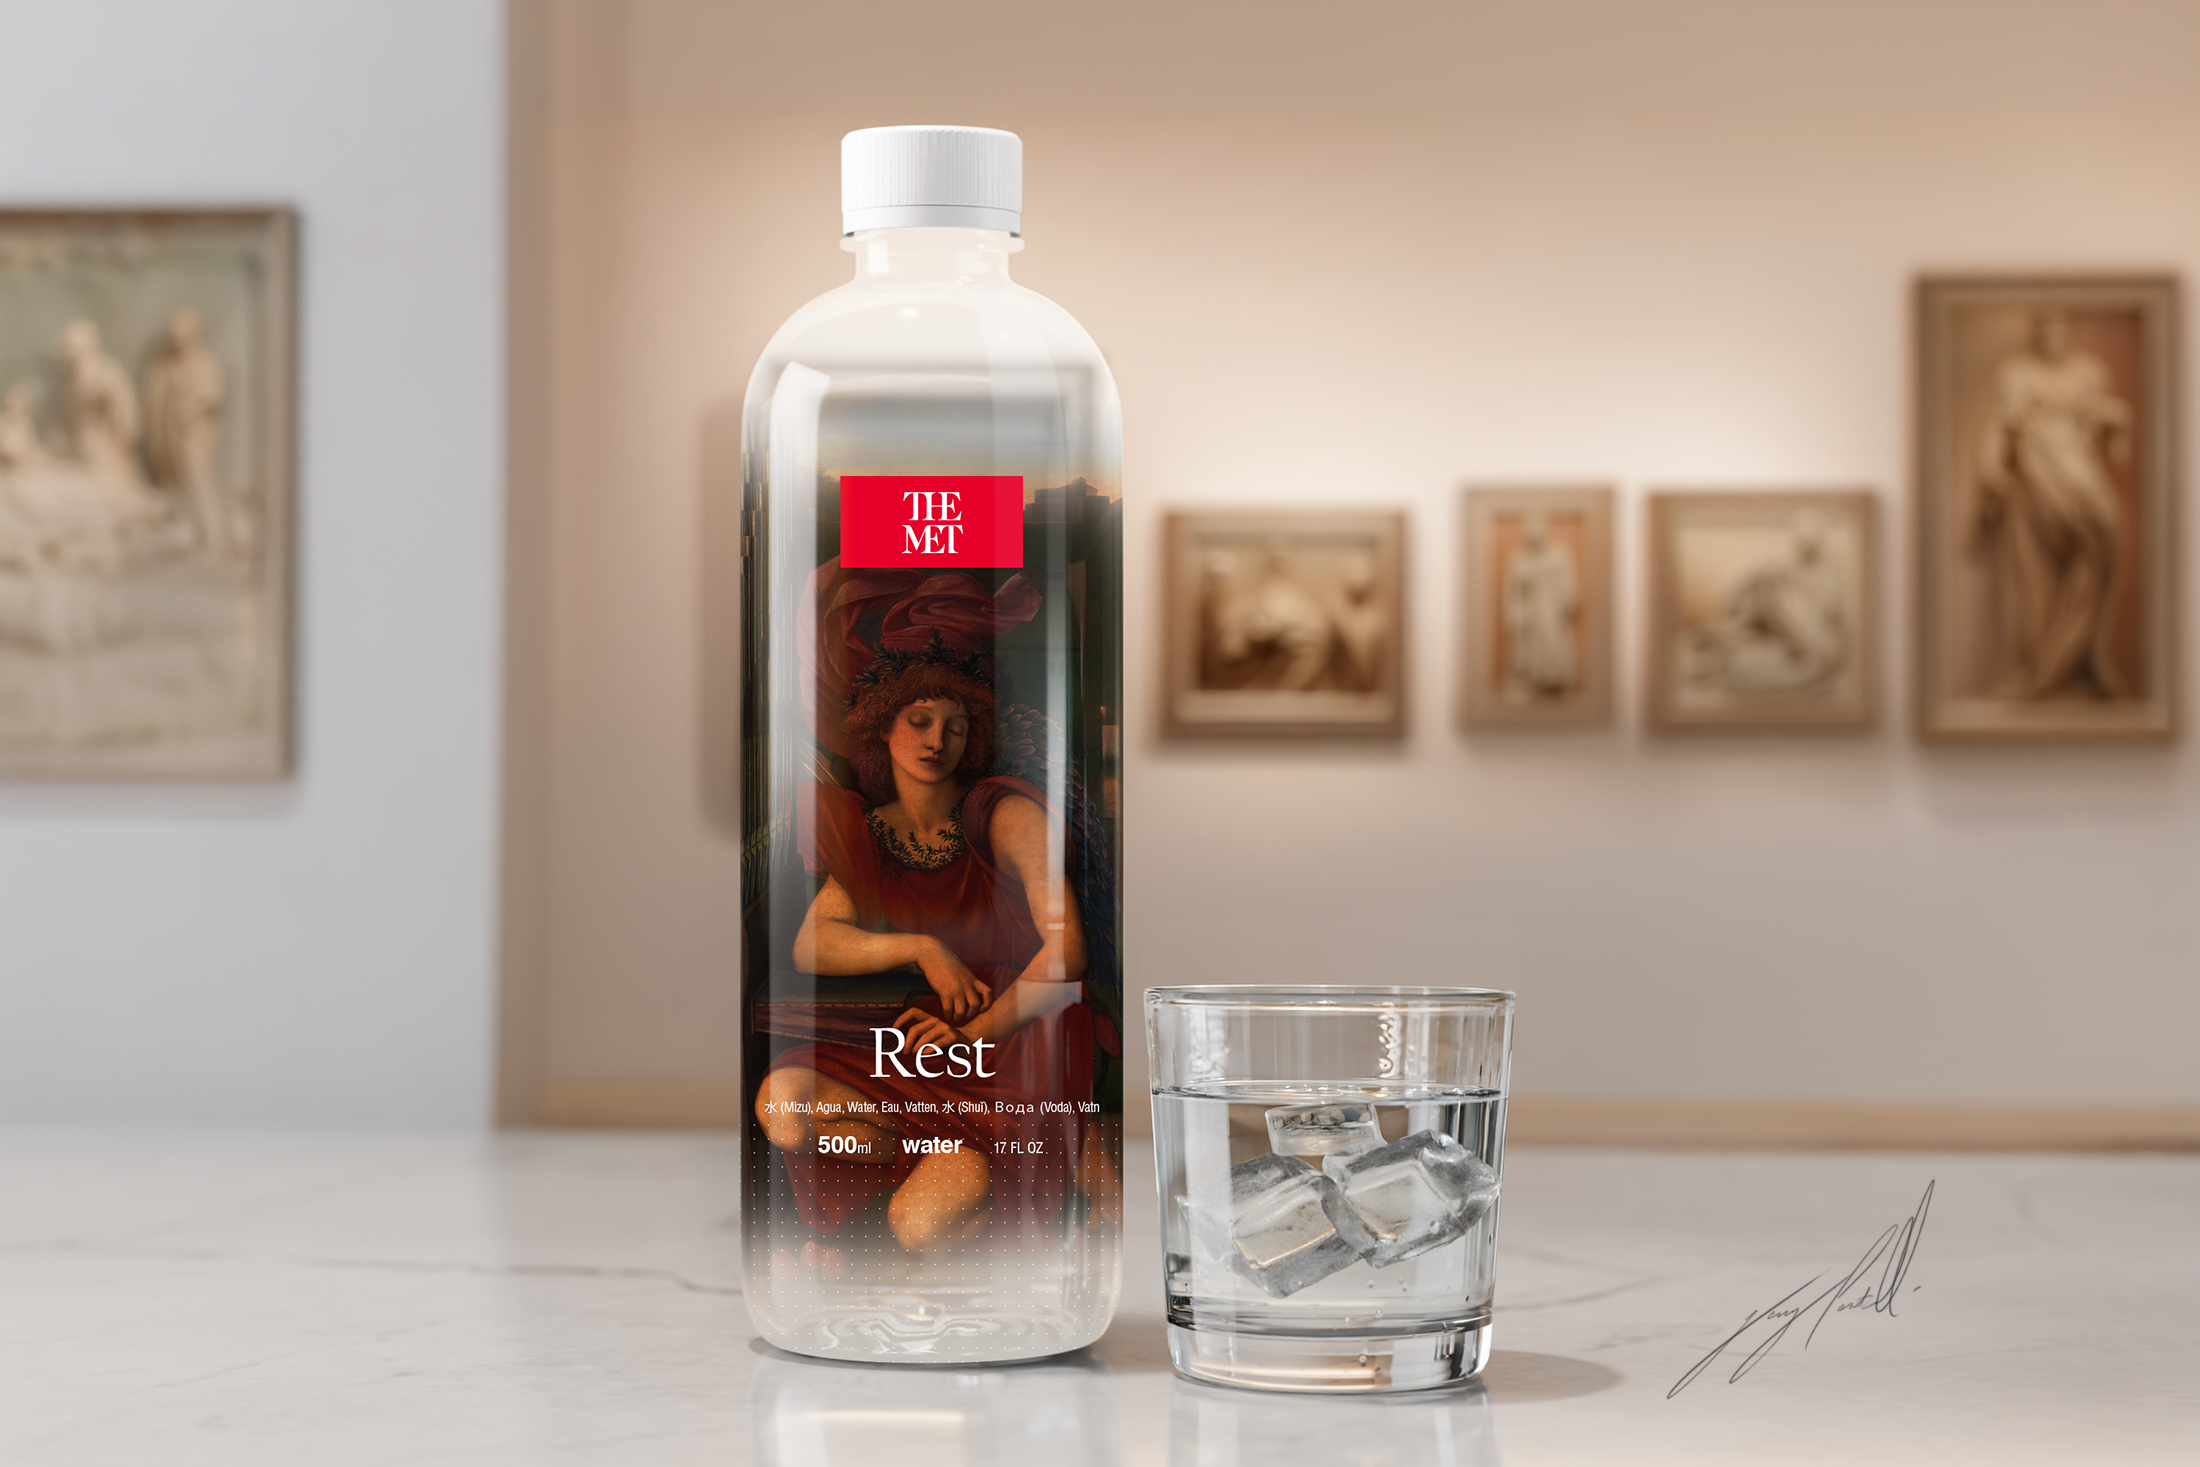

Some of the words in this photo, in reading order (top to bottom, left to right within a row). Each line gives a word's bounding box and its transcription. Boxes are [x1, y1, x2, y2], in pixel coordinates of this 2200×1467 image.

[903, 491, 962, 521] THE
[902, 524, 963, 554] MET
[870, 1027, 997, 1079] Rest
[764, 1100, 778, 1114] 水
[780, 1101, 814, 1116] (Mizu),
[816, 1101, 845, 1115] Agua,
[847, 1101, 879, 1115] Water,
[881, 1101, 903, 1115] Eau,
[905, 1101, 939, 1115] Vatten,
[941, 1100, 956, 1114] 水
[995, 1101, 1035, 1115] Вода
[1040, 1101, 1075, 1116] (Voda),
[1077, 1101, 1100, 1113] Vatn
[902, 1136, 963, 1154] water
[994, 1141, 1007, 1154] 17
[1010, 1141, 1025, 1154] FL
[1027, 1141, 1044, 1154] OZ
